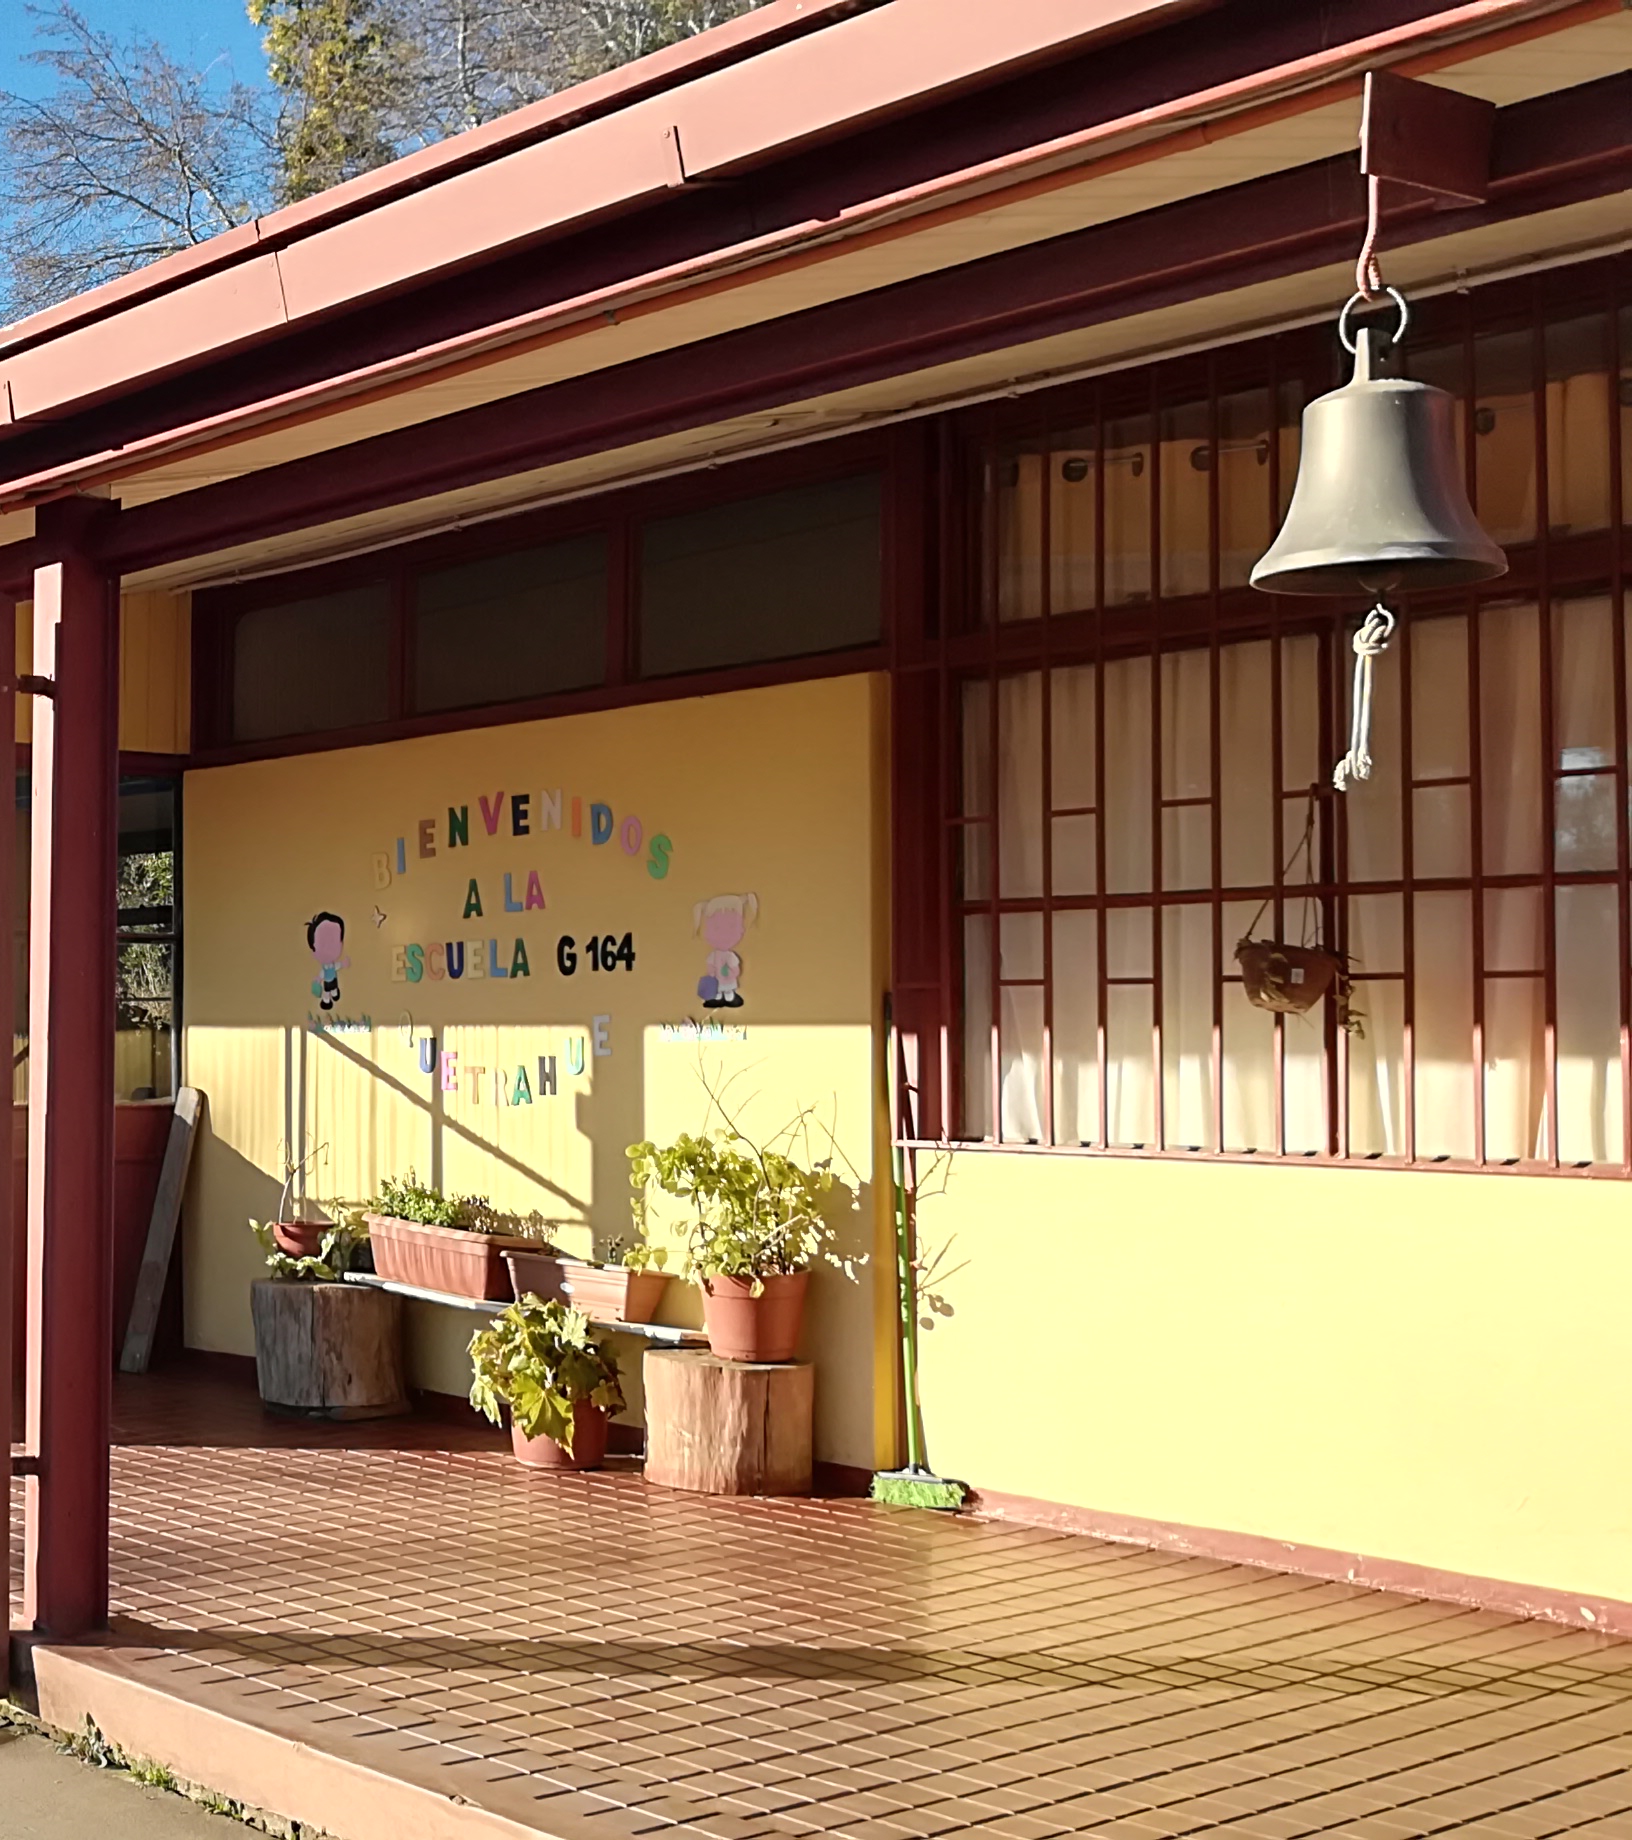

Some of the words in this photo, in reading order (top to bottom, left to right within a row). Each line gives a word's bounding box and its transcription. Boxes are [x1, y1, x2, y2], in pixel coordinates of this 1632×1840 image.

[372, 789, 673, 890] BIENVENIDOS
[463, 878, 483, 918] A
[505, 870, 546, 912] LA
[391, 938, 530, 983] ESCUELA
